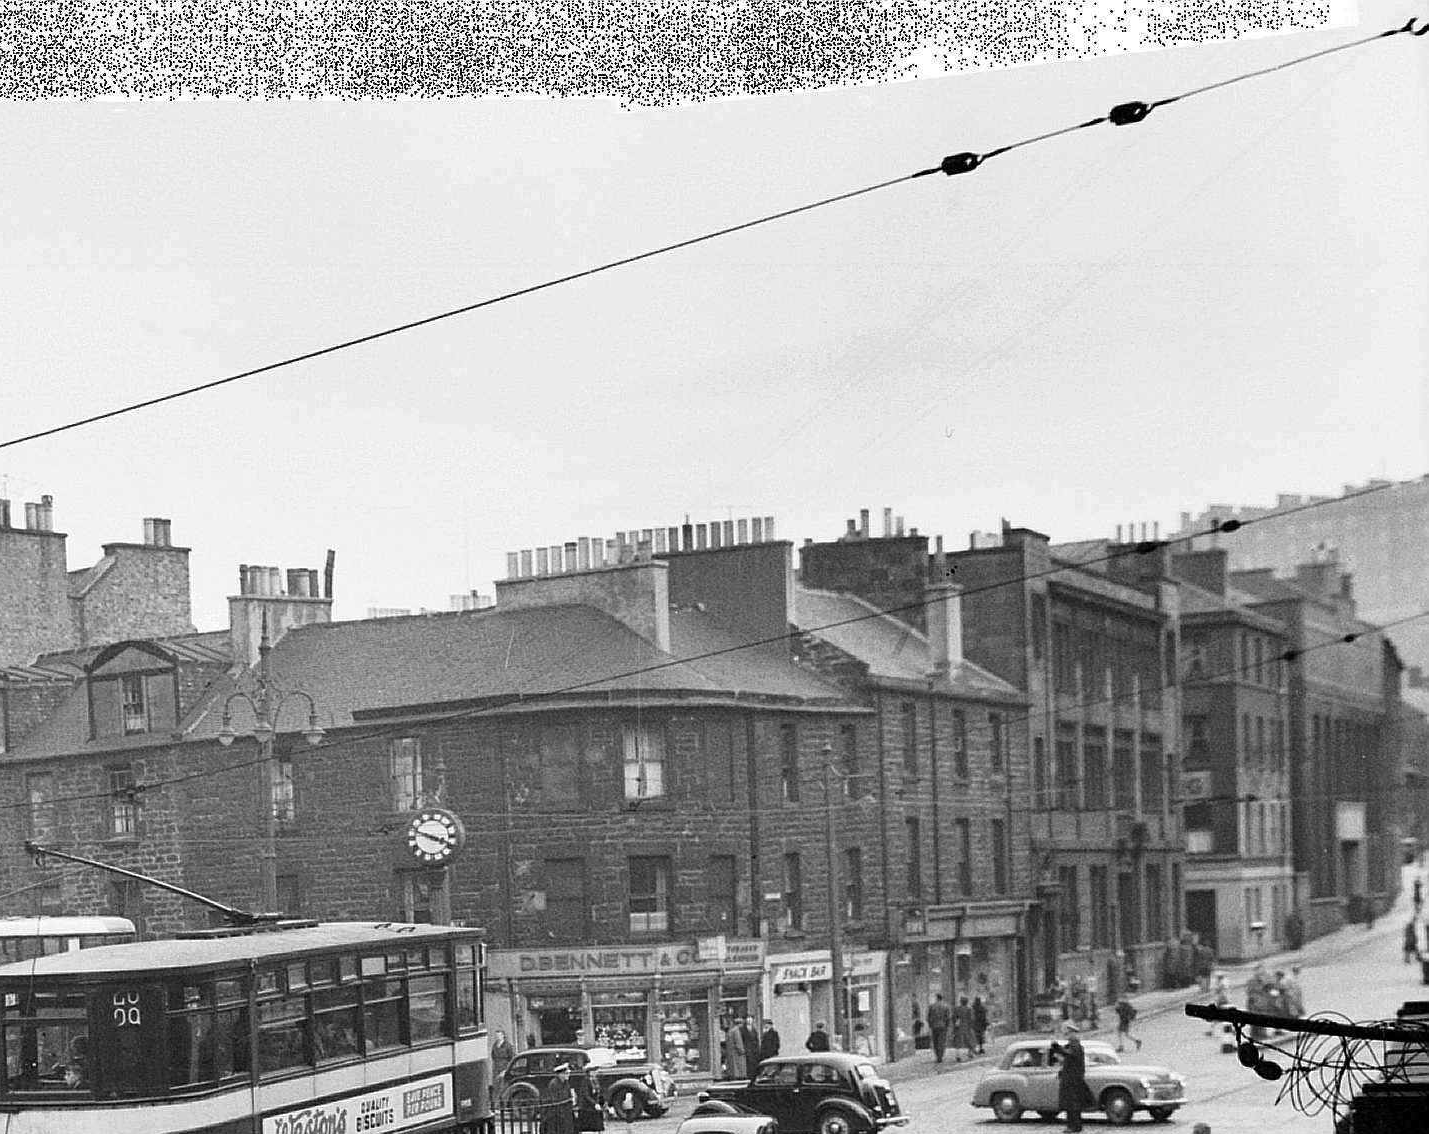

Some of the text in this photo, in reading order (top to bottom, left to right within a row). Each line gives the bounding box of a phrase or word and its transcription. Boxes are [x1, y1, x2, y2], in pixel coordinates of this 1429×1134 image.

[660, 952, 671, 967] &
[360, 1096, 390, 1114] QUALITY
[356, 1108, 395, 1133] BISCUITS
